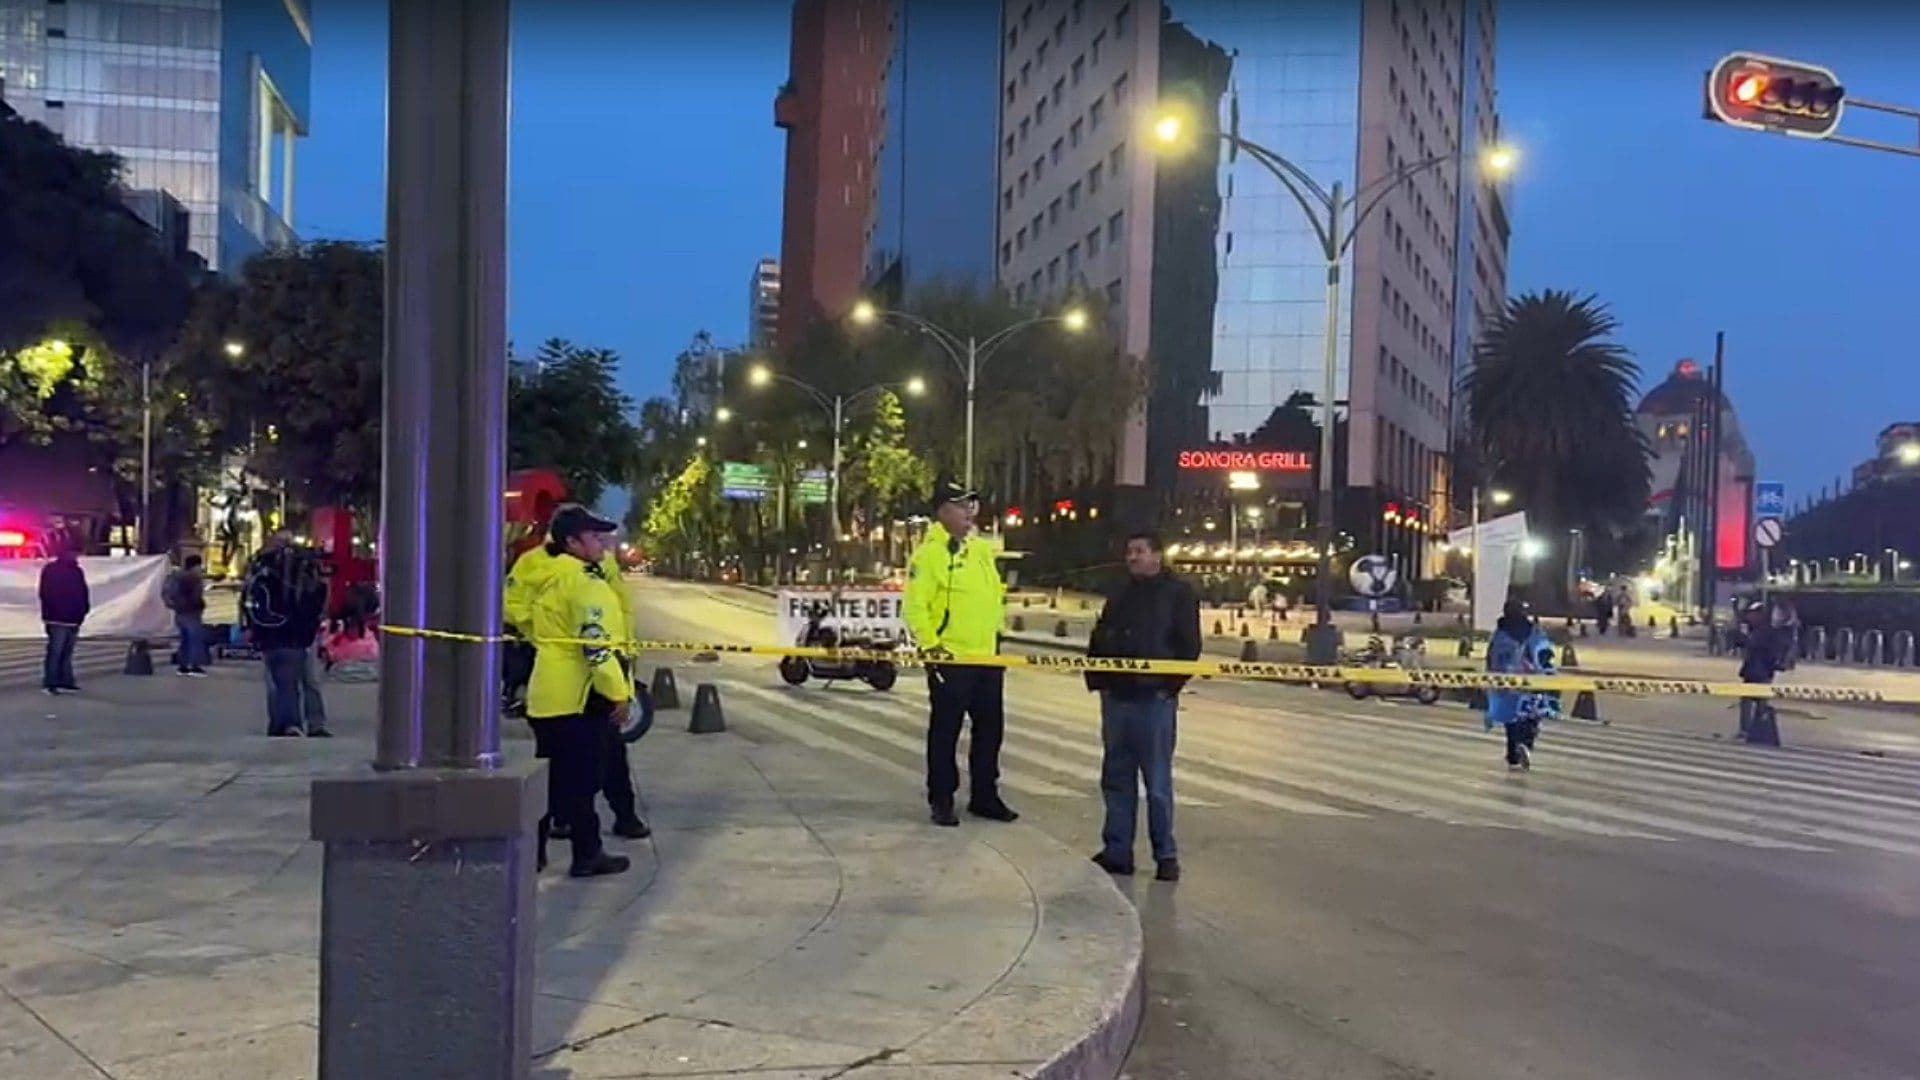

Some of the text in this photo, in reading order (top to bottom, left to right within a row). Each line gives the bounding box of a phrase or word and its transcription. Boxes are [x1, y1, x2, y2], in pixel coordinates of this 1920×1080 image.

[1179, 451, 1312, 469] SONORA GRILL
[866, 599, 891, 618] DE
